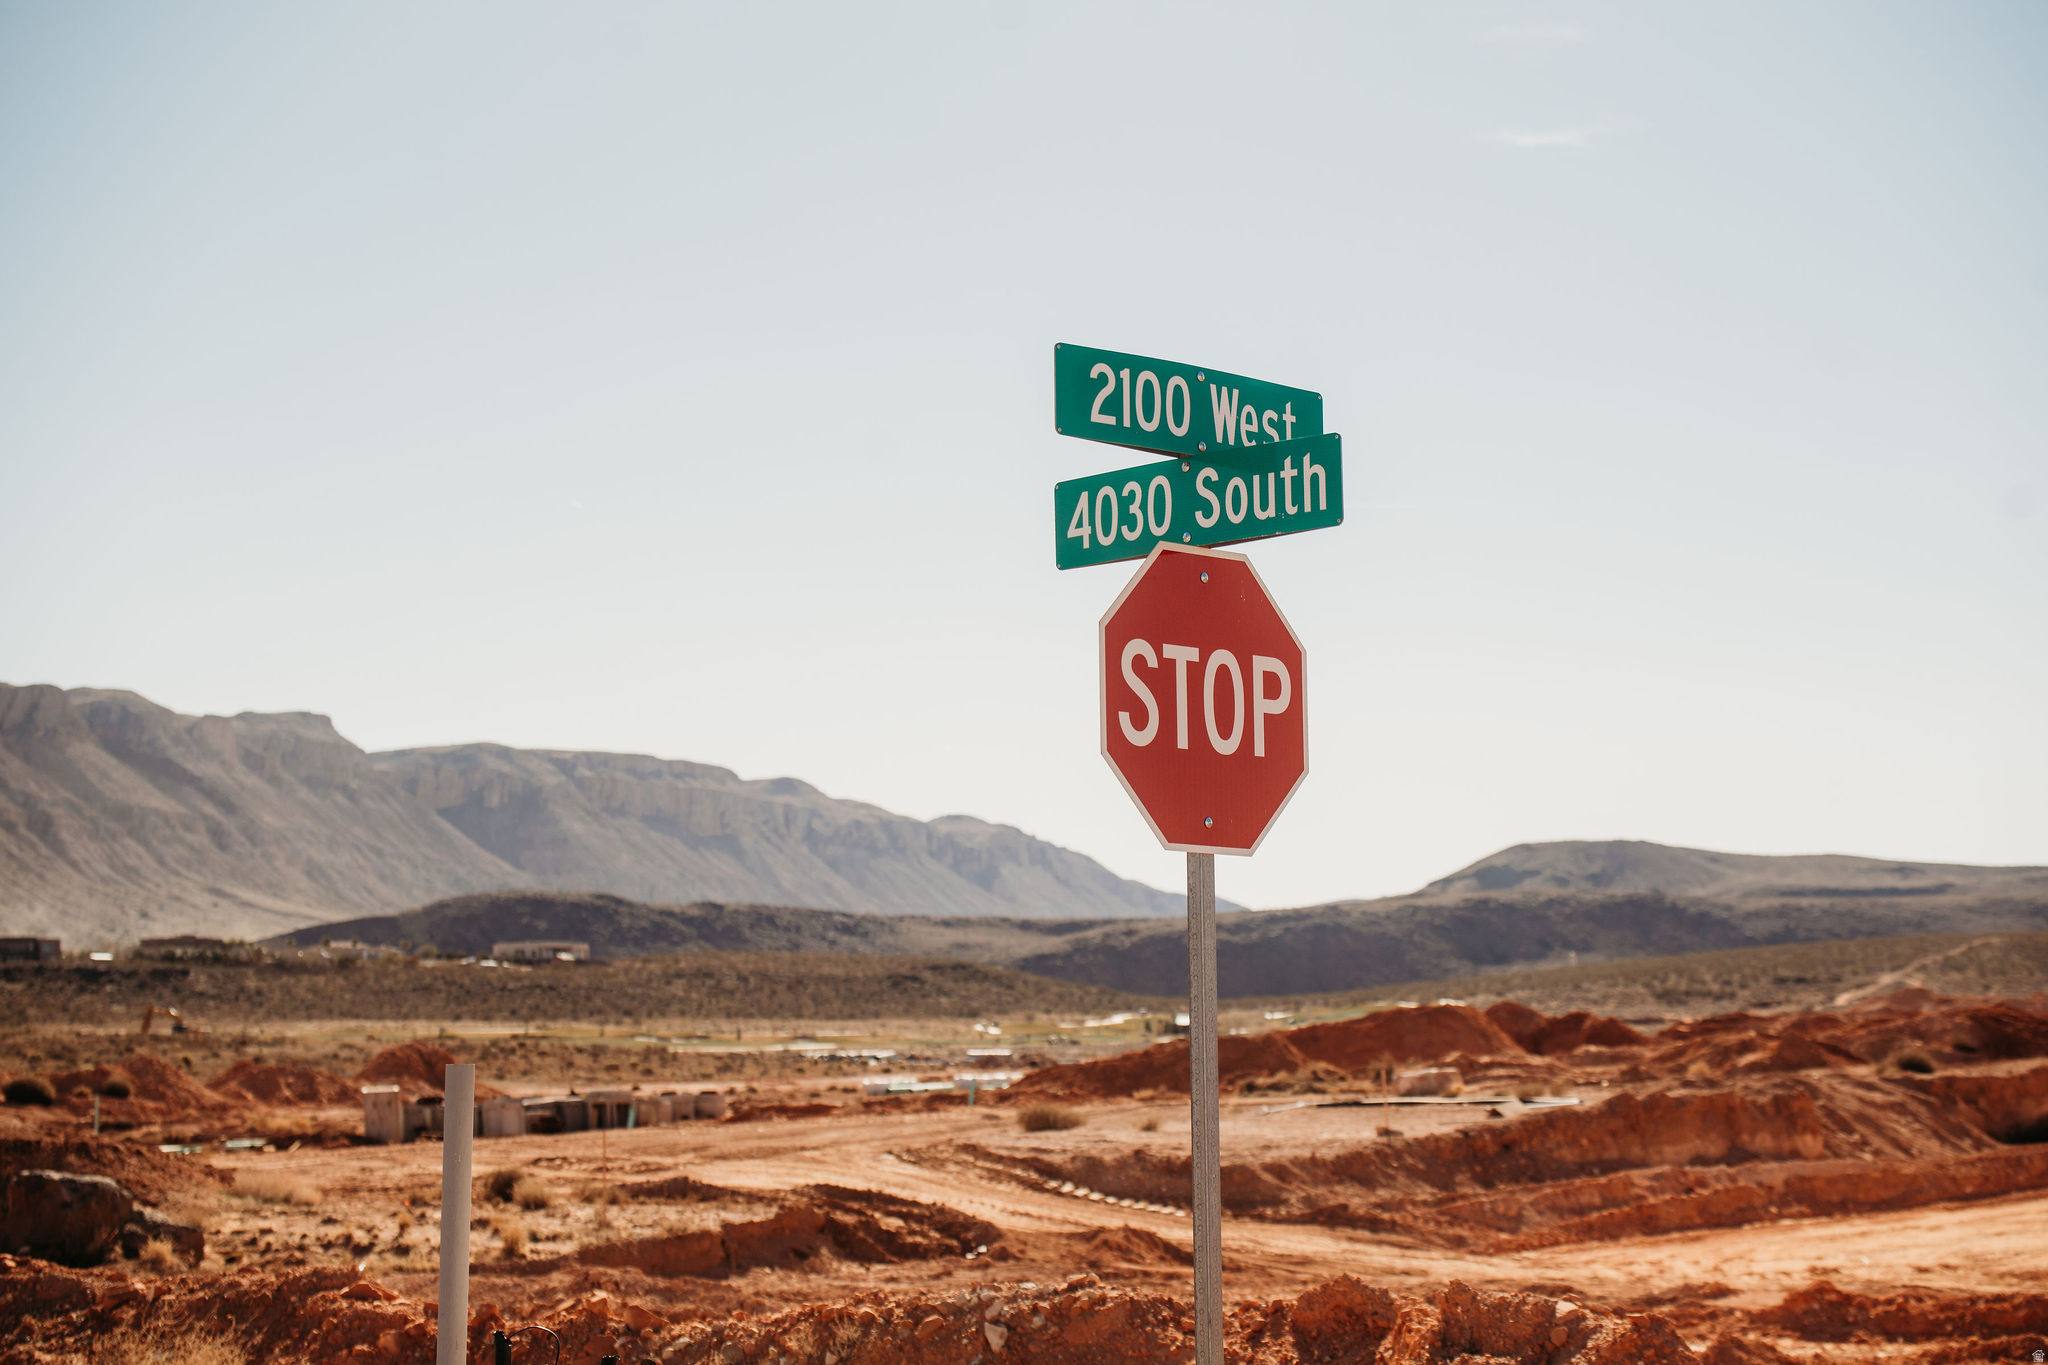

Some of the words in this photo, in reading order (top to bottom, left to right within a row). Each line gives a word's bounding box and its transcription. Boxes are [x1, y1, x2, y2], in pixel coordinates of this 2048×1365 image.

[1090, 362, 1191, 437] 2100
[1210, 383, 1297, 447] West
[1067, 475, 1173, 549] 4030
[1194, 452, 1327, 528] South
[1118, 638, 1292, 757] STOP
